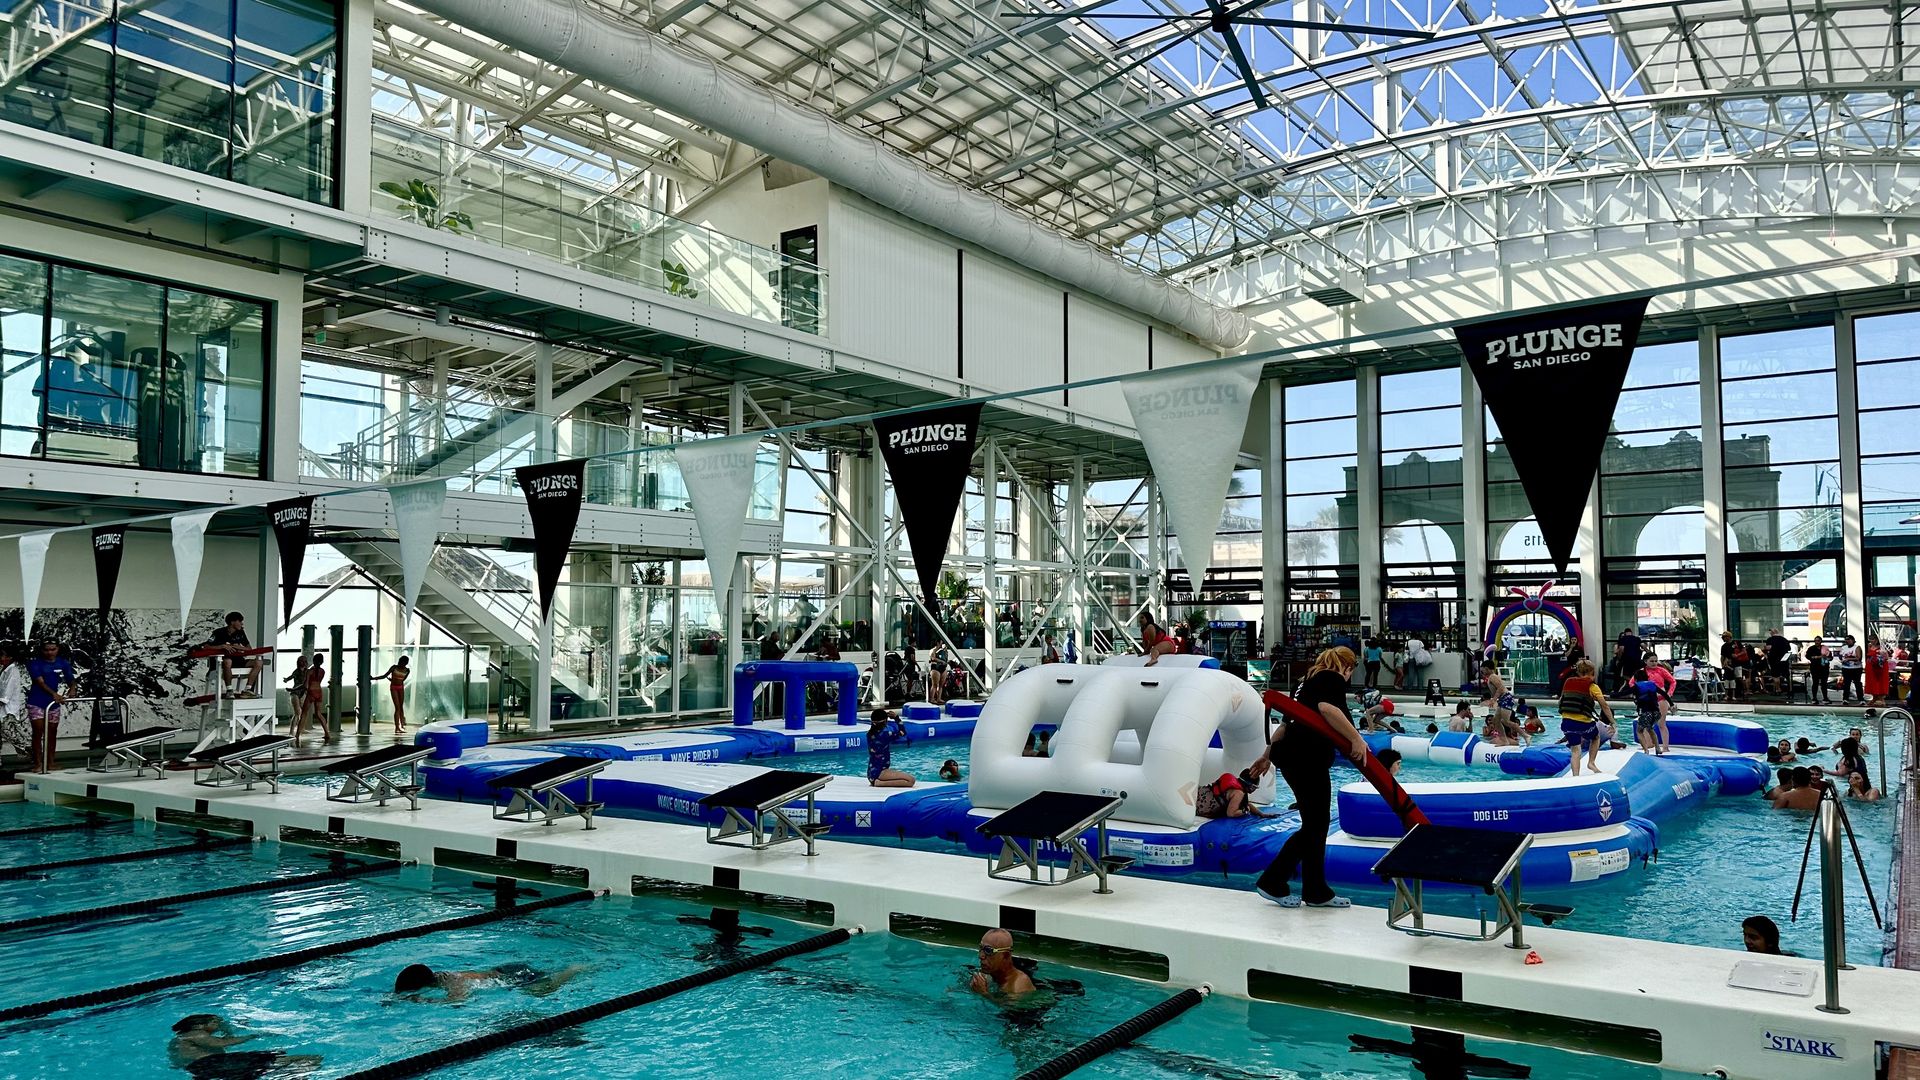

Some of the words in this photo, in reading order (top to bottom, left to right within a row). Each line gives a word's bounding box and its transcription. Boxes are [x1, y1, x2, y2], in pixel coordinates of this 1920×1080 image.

[1486, 324, 1623, 364] PLUNGE
[1513, 357, 1542, 370] SAN
[1546, 352, 1591, 366] DIEGO
[889, 424, 967, 448] PLUNGE
[904, 446, 920, 455] SAN
[921, 443, 949, 452] DIEGO
[529, 474, 578, 495] PLUNGE
[547, 490, 568, 498] DIEGO
[273, 507, 308, 525] PLUNGE
[95, 533, 122, 547] PLUNGE
[845, 737, 861, 748] HALO
[670, 752, 691, 763] WAVE
[692, 749, 711, 762] RIDER
[712, 748, 719, 759] 10
[240, 770, 246, 780] 6
[380, 786, 386, 796] 5
[554, 802, 561, 813] 4
[1473, 811, 1491, 822] DOG
[1492, 809, 1509, 820] LEG
[778, 826, 783, 838] 3
[1074, 860, 1079, 874] 2
[1771, 1035, 1838, 1057] STARK
